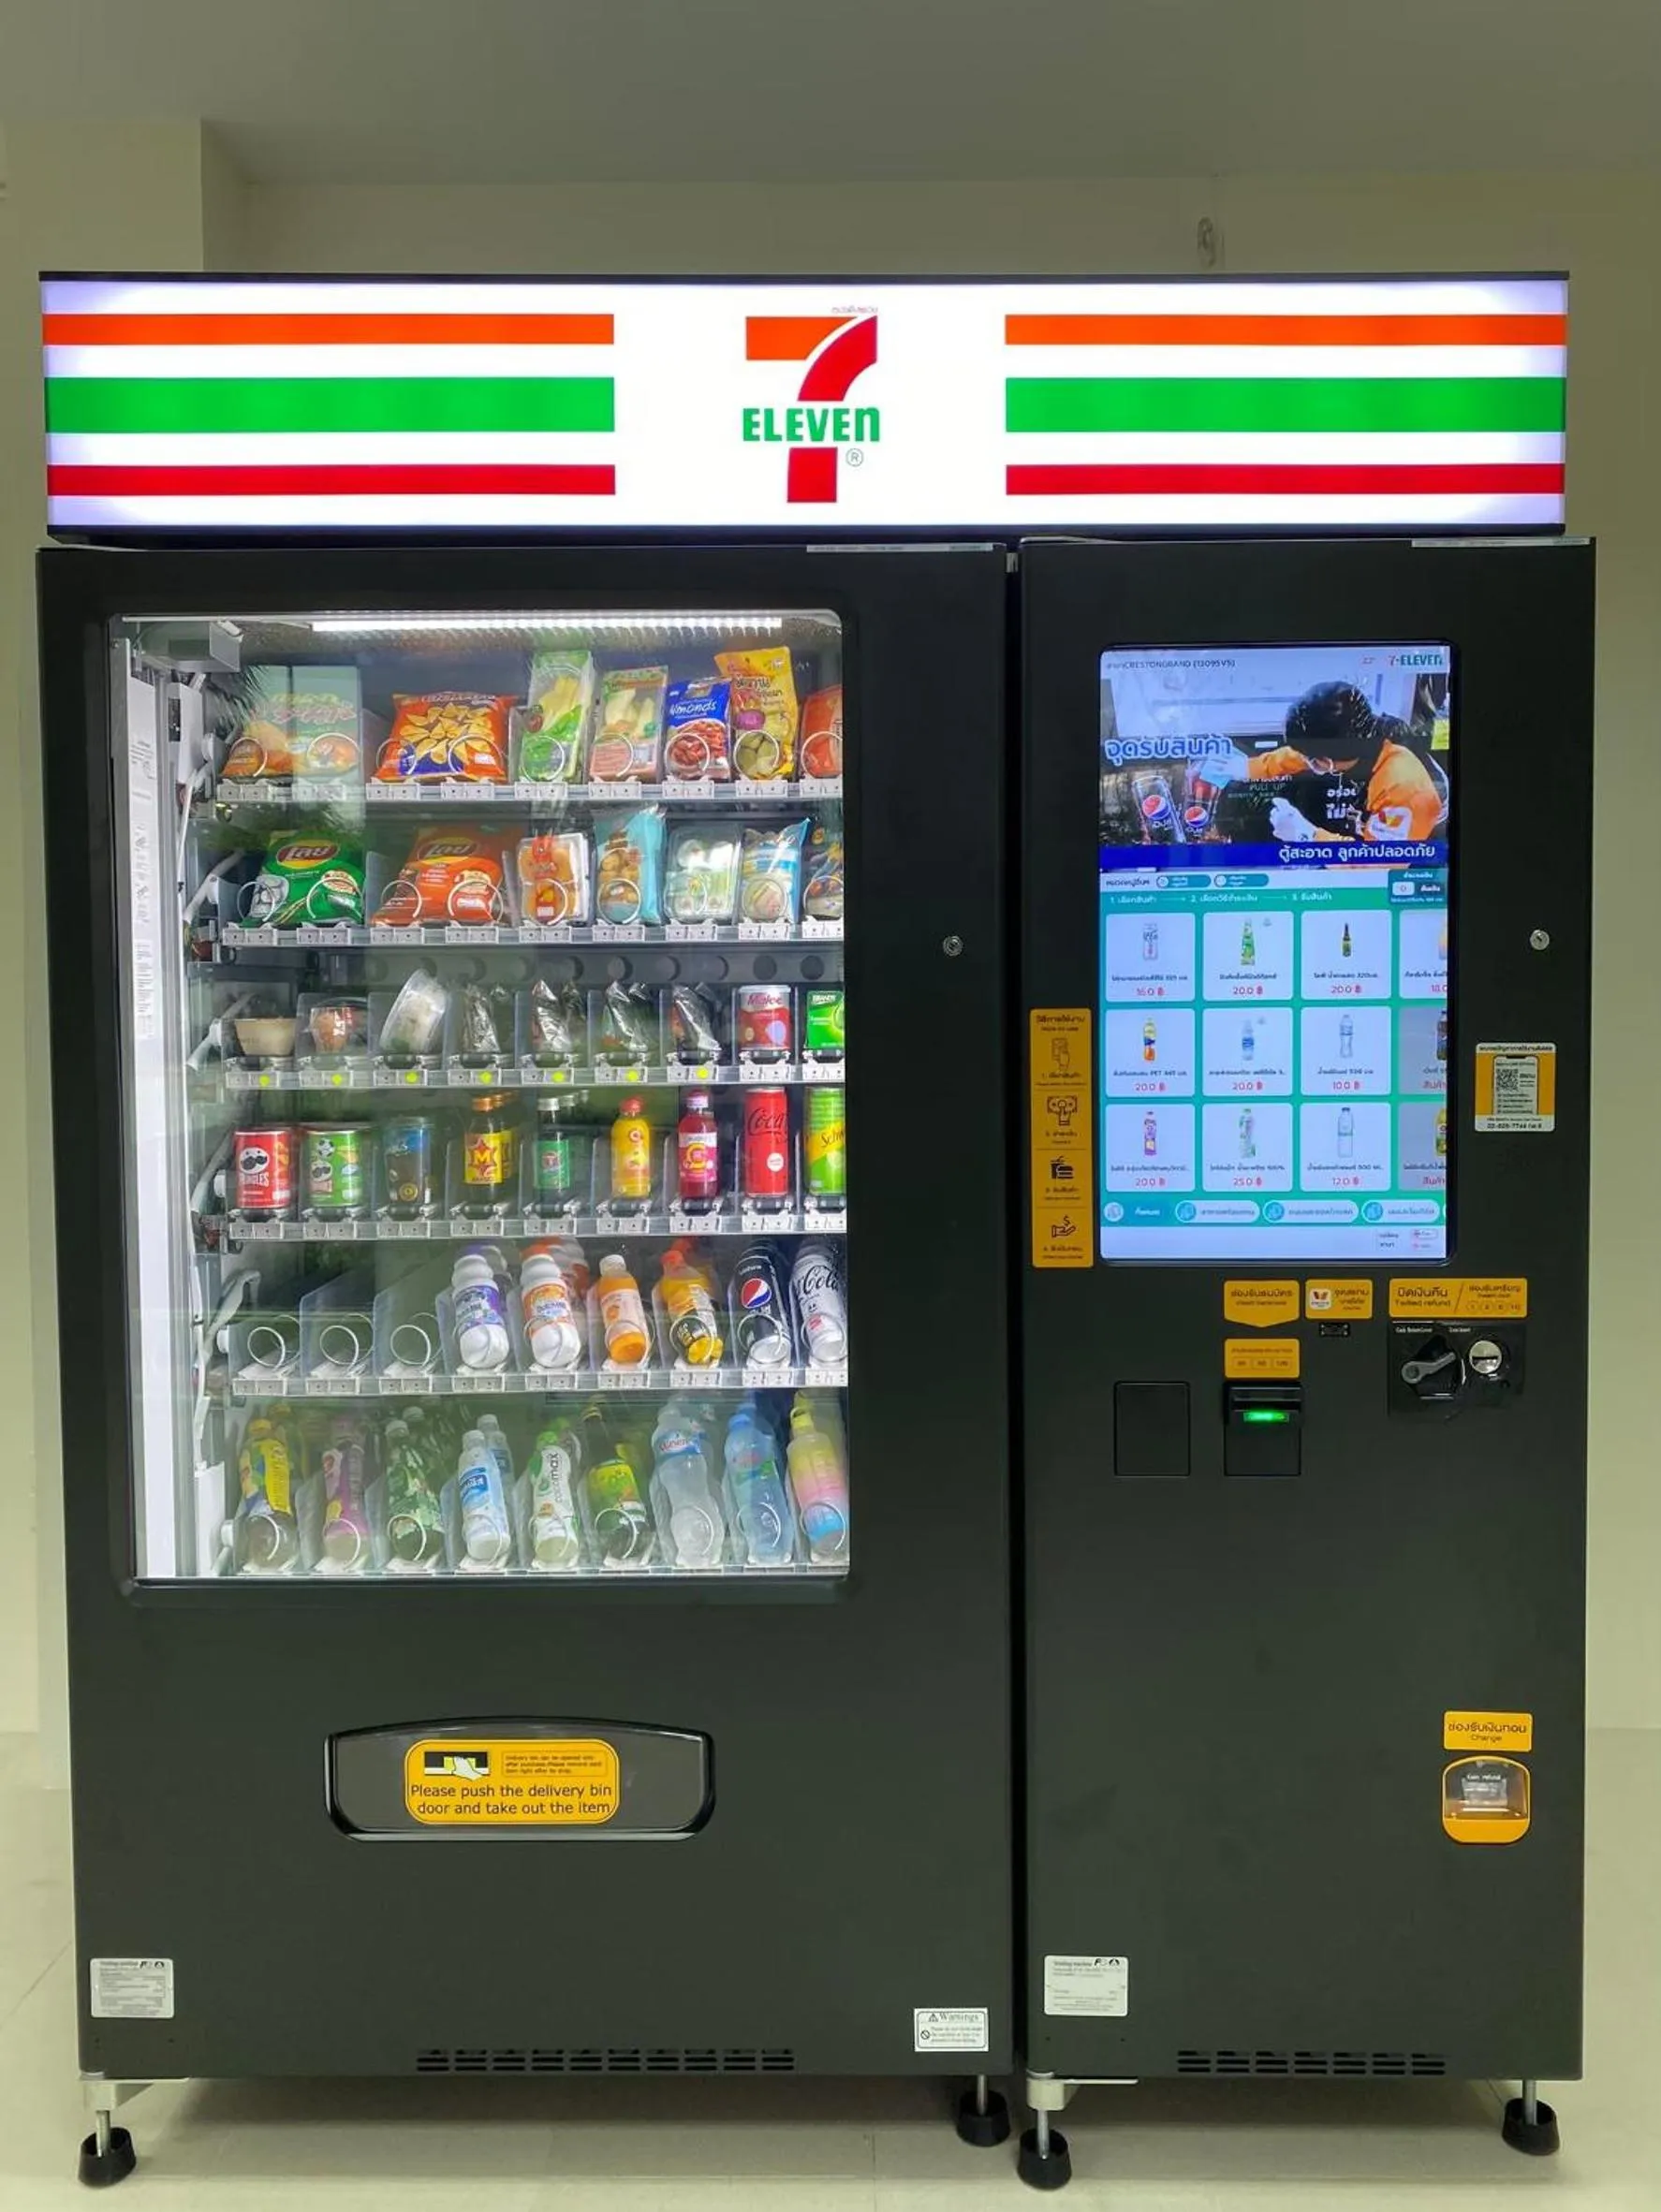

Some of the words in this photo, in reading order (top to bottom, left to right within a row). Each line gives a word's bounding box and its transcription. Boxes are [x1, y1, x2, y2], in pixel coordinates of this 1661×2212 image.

[745, 315, 878, 503] 7
[1278, 843, 1333, 862] ตู้สะอาด
[1338, 843, 1436, 862] ลูกค้าปลอดภัย
[750, 1107, 786, 1135] Coca
[1448, 1721, 1527, 1735] ช่องรับเงินทอน
[410, 1784, 456, 1797] Please
[461, 1784, 495, 1800] push
[500, 1784, 524, 1797] the
[527, 1784, 585, 1799] delivery
[589, 1784, 612, 1797] bin
[417, 1801, 450, 1815] door
[455, 1801, 481, 1814] and
[485, 1801, 517, 1814] take
[522, 1803, 546, 1814] out
[550, 1801, 574, 1814] the
[578, 1801, 610, 1814] item
